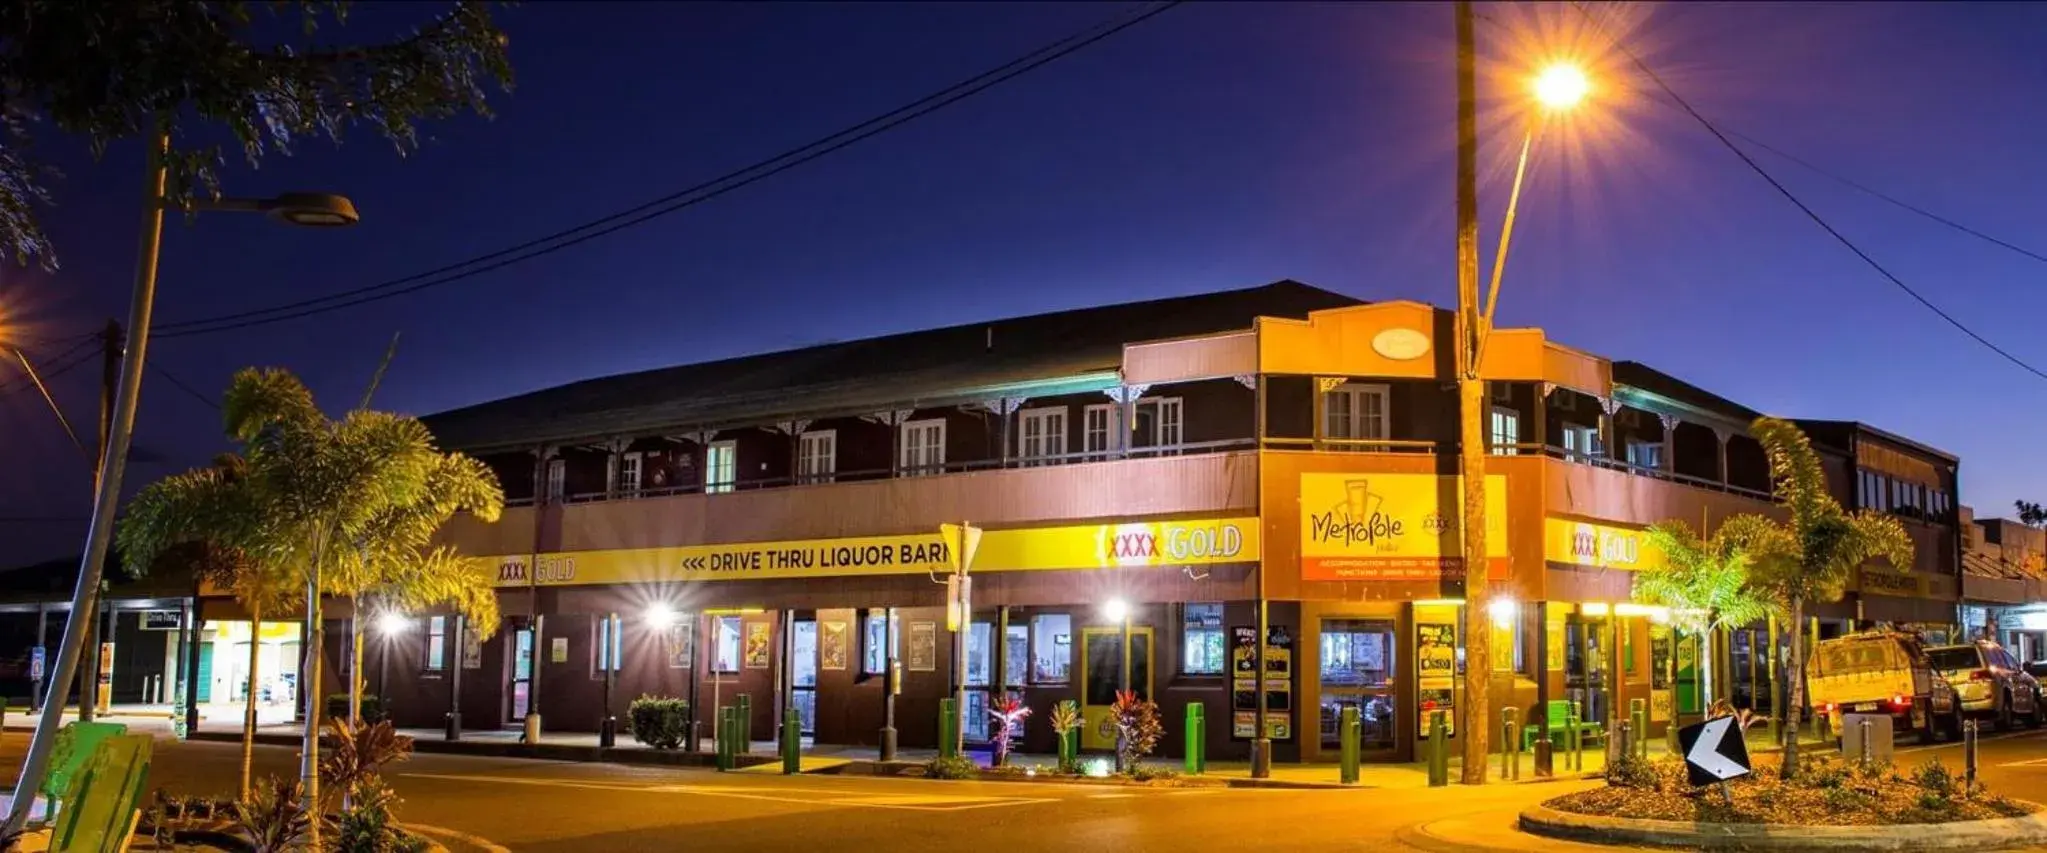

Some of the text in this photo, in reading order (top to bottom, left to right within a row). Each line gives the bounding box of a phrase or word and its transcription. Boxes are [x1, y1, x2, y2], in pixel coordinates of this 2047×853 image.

[1107, 524, 1241, 560] XXXX GOLD
[1571, 531, 1638, 563] XXXX GOLD
[498, 557, 575, 582] XXXX GOLD
[710, 551, 761, 572] DRIVE
[767, 548, 814, 570] THRU
[820, 544, 894, 569] LIQUOR
